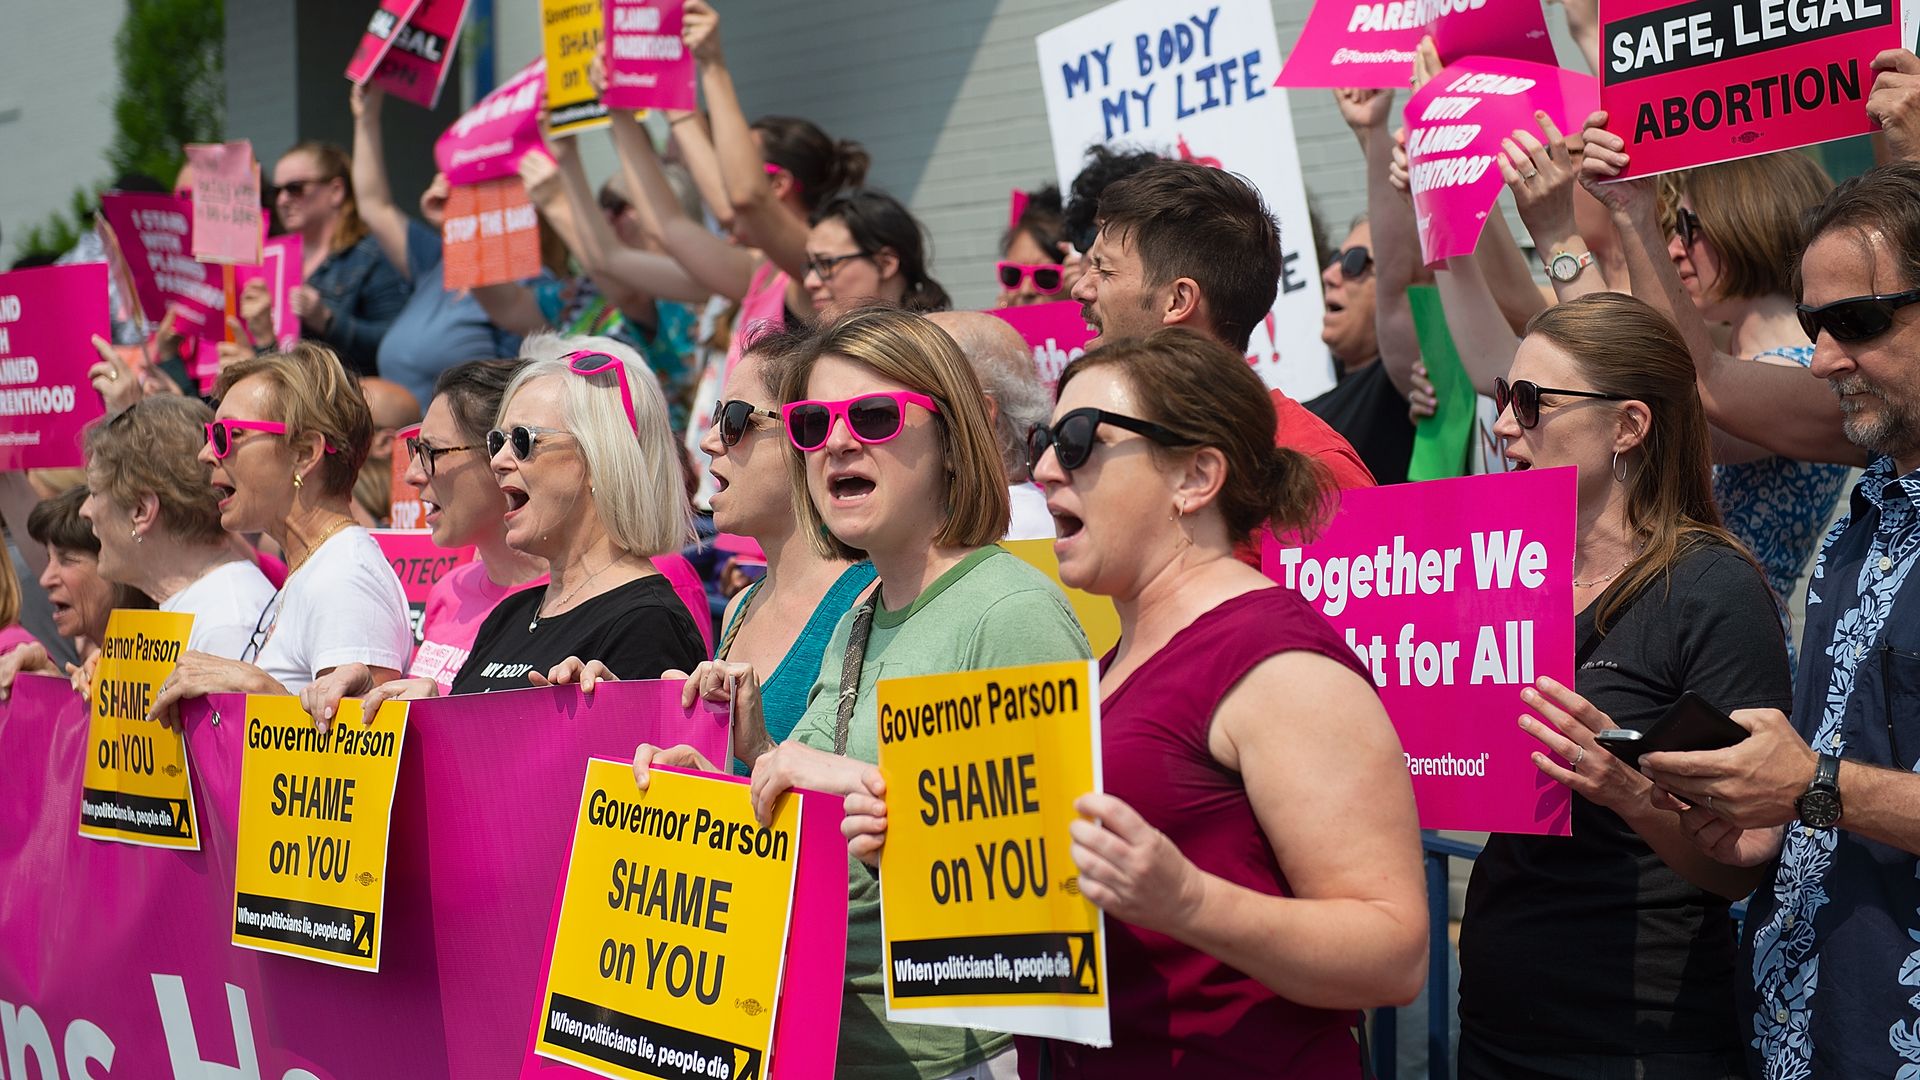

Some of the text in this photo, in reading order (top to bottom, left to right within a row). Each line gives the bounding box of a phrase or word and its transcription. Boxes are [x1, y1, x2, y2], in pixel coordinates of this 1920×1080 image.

[1062, 7, 1219, 99] MY BODY
[1611, 10, 1724, 73] SAFE,
[1733, 0, 1882, 46] LEGAL
[1101, 50, 1266, 141] MY LIFE
[1420, 97, 1482, 121] WITH
[1455, 73, 1536, 95] STAND
[1633, 59, 1862, 145] ABORTION
[0, 385, 75, 416] RENTHOOD
[386, 556, 458, 585] OTECT
[1280, 529, 1548, 617] Together We
[135, 632, 181, 663] Parson
[480, 662, 533, 679] MY BODY
[1345, 620, 1535, 687] ht for All
[99, 678, 151, 721] SHAME
[881, 677, 1078, 744] Governor Parson
[121, 733, 154, 776] YOU
[248, 717, 395, 758] Governor Parson
[271, 773, 356, 822] SHAME
[918, 754, 1040, 826] SHAME
[588, 789, 788, 862] Governor Parson
[269, 835, 351, 883] on YOU
[930, 838, 1048, 905] on YOU
[237, 906, 352, 942] When politicians lie, people die
[608, 858, 733, 933] SHAME
[599, 937, 725, 1005] on YOU
[894, 951, 1071, 986] When politicians lie, people die
[551, 1010, 730, 1080] When politicians lie, people die
